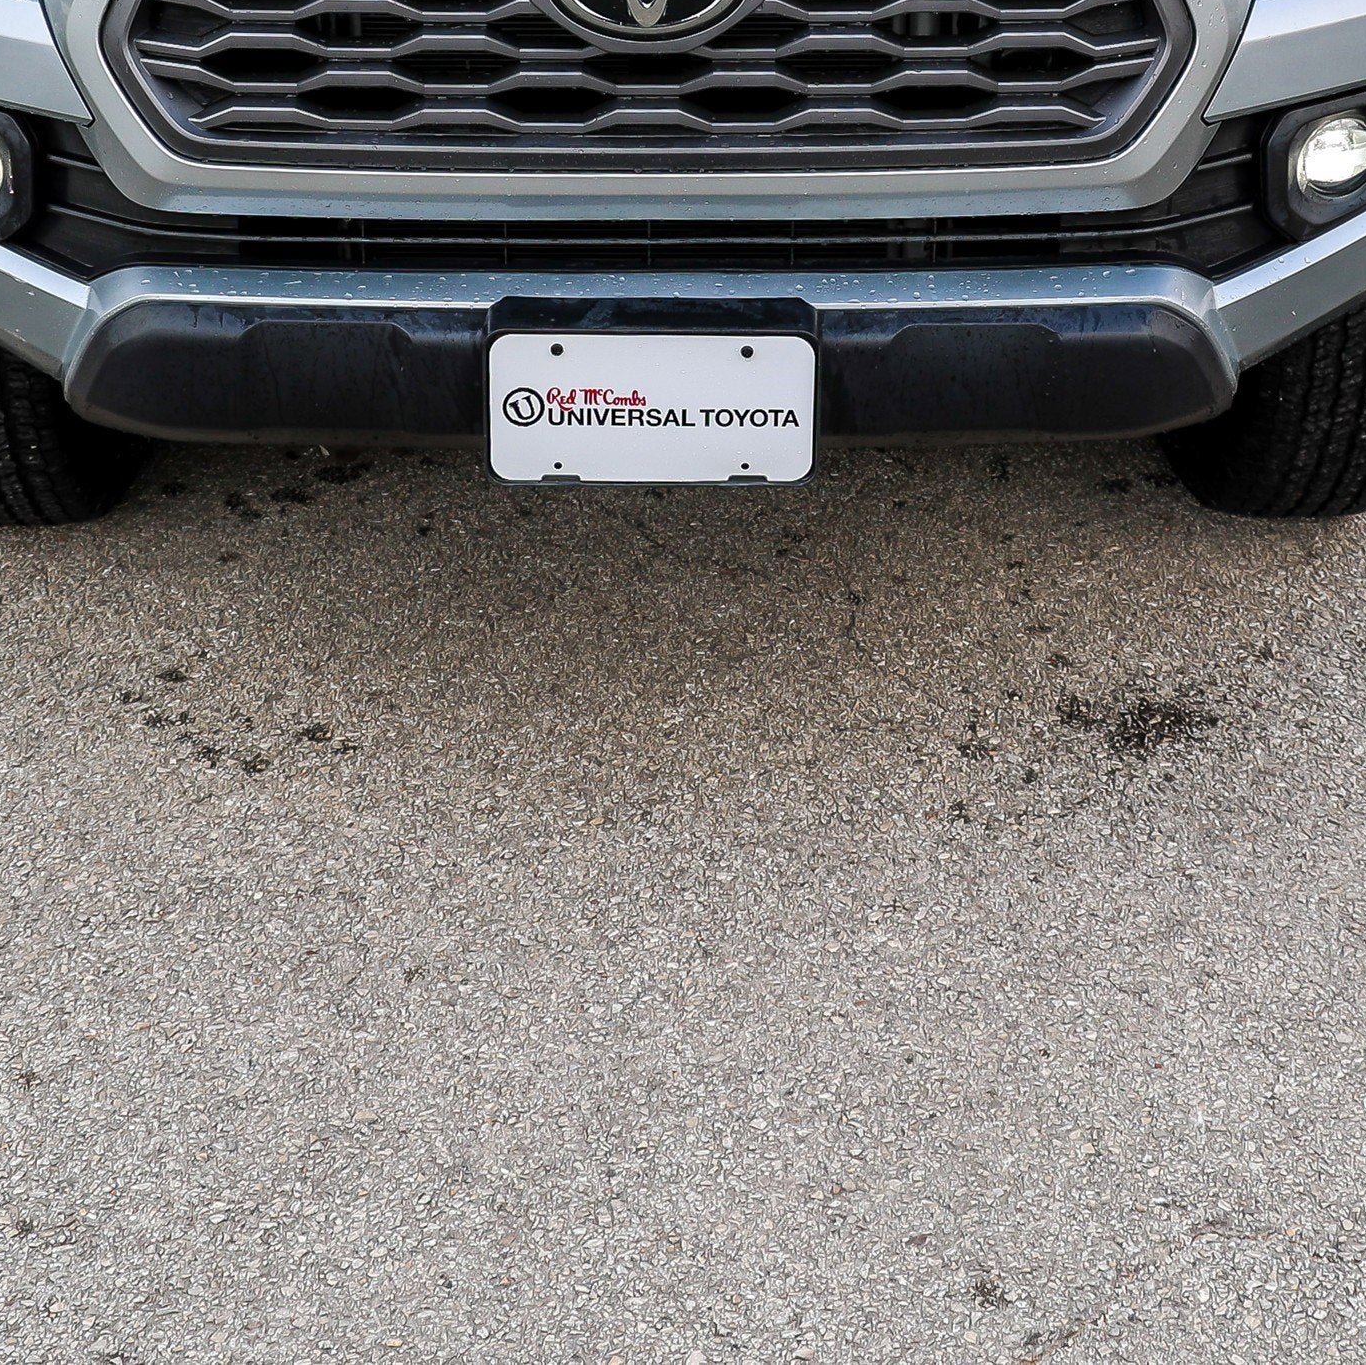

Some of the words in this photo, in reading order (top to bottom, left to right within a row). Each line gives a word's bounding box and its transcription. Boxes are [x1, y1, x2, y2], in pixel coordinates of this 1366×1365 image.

[579, 388, 646, 406] McCombs
[548, 408, 696, 427] UNIVERSAL
[700, 409, 800, 427] TOYOTA
